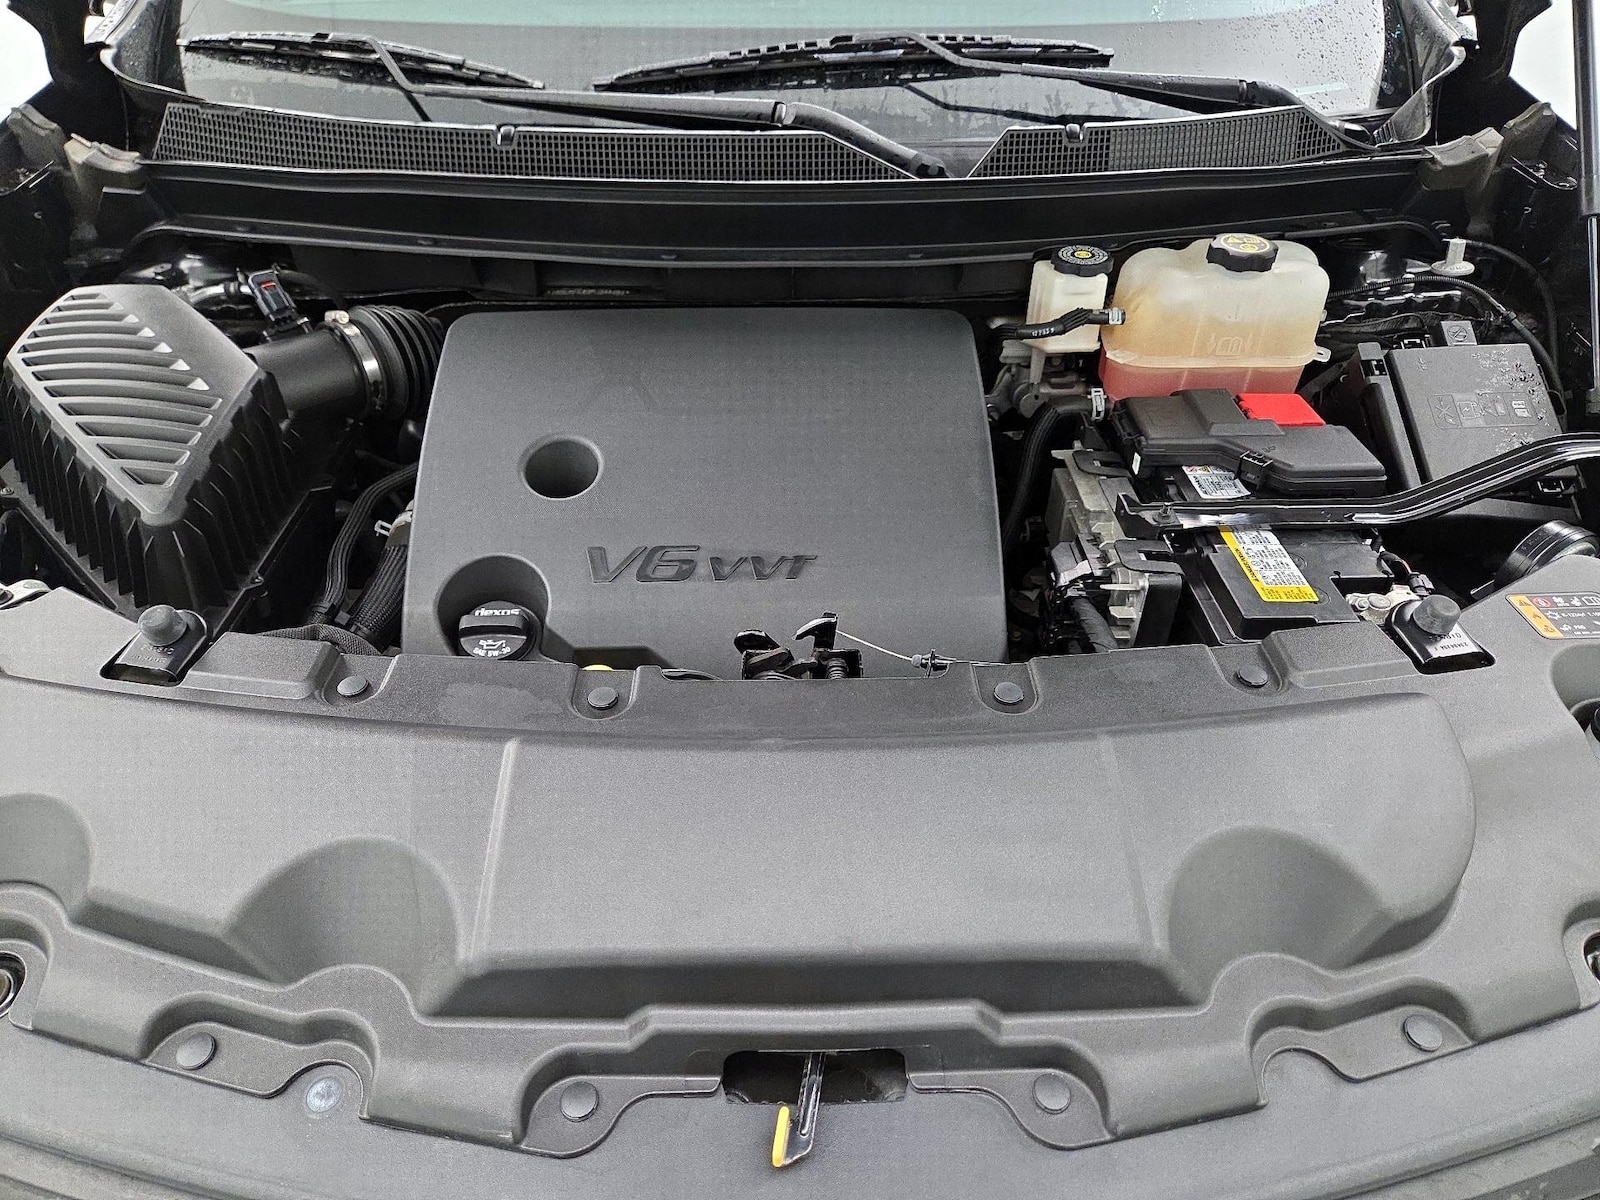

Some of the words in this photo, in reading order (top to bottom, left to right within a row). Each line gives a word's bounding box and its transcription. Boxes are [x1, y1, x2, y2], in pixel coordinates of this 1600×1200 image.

[586, 545, 700, 583] V6
[707, 554, 818, 581] VVT
[474, 607, 522, 616] dexos
[472, 647, 487, 657] SAE
[487, 646, 511, 657] 5W-30
